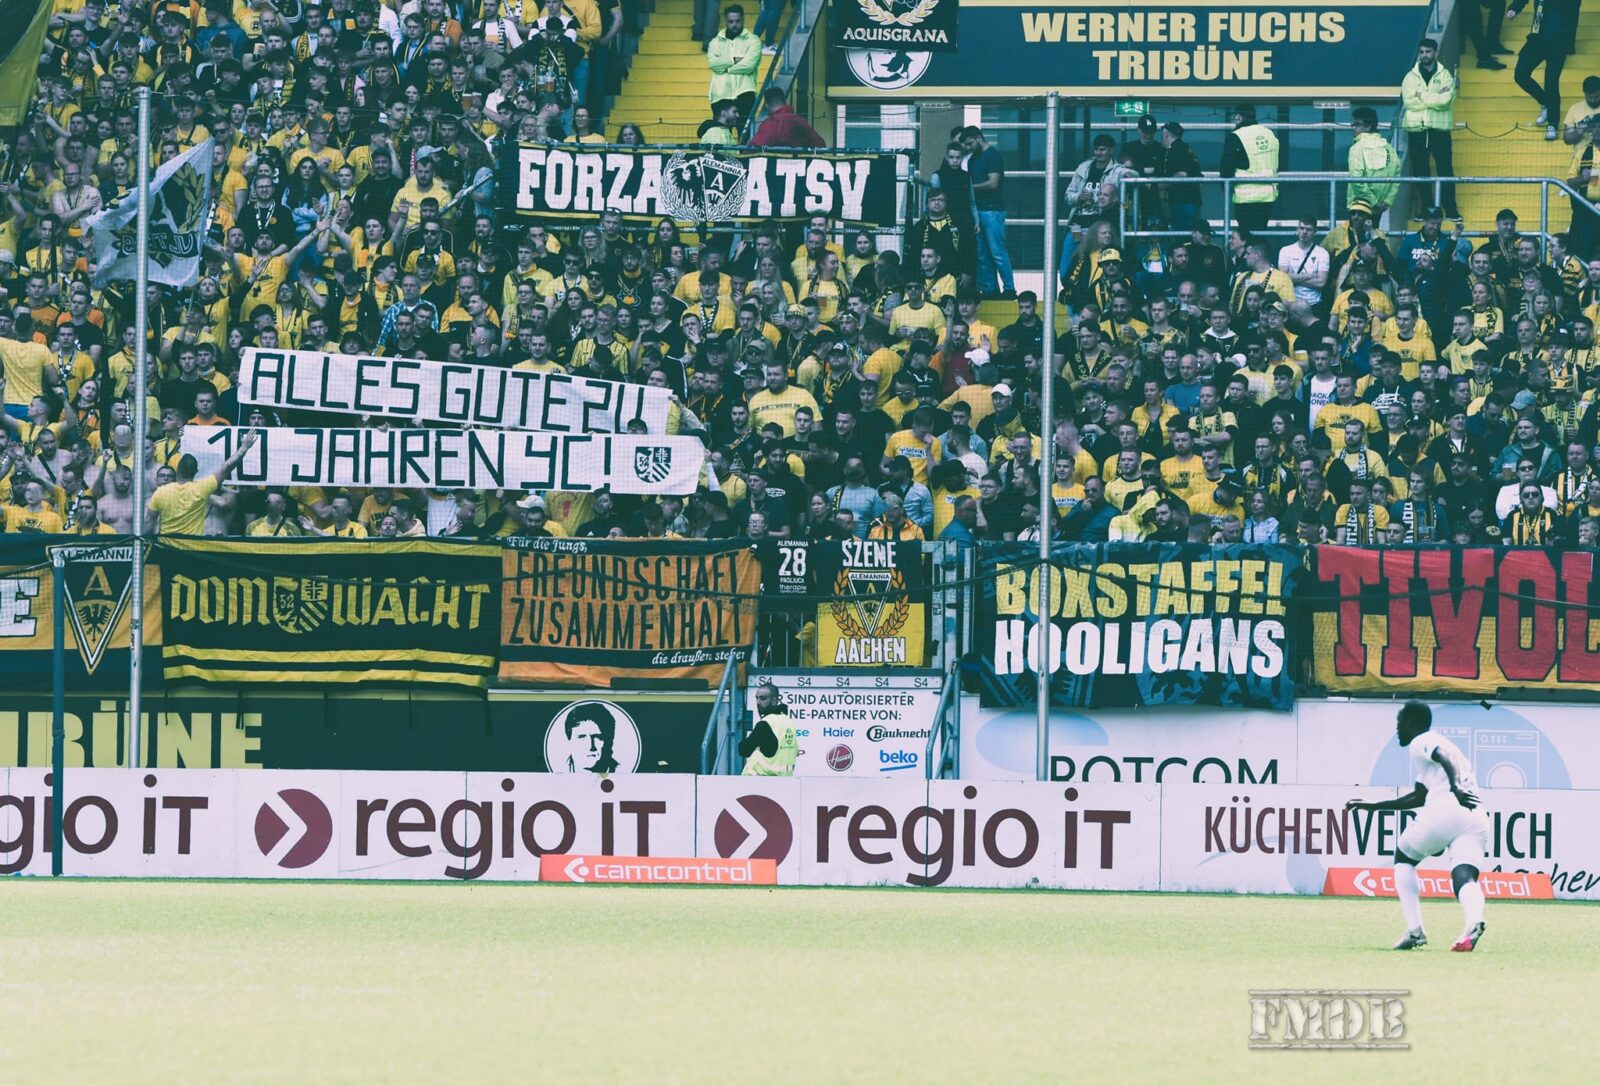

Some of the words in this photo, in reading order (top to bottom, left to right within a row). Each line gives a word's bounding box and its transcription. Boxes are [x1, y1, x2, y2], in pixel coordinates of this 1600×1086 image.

[843, 27, 948, 44] AQUISGRANA
[1022, 12, 1195, 43] WERNER
[1208, 11, 1345, 43] FUCHS
[1093, 45, 1272, 80] TRIBÜNE
[516, 148, 668, 214] FORZA
[738, 157, 871, 220] ATSV
[251, 352, 421, 414] ALLES
[439, 365, 572, 432] GUTE
[207, 428, 268, 482] 10
[291, 428, 505, 488] JAHREN
[520, 435, 612, 492] YC!
[59, 547, 133, 560] ALEMANNI
[507, 536, 531, 548] Für
[533, 536, 550, 550] die
[553, 539, 588, 554] Jungs,
[841, 539, 897, 568] SZENE
[516, 551, 741, 601] FREUNDSCHAFT
[778, 548, 807, 577] 28
[83, 566, 113, 596] A
[996, 559, 1287, 618] BOXSTAFFEL
[508, 598, 742, 650] ZUSAMMENHALT
[1317, 544, 1600, 682] TIVOL
[652, 652, 668, 664] die
[671, 650, 712, 666] draußen
[835, 637, 906, 664] AACHEN
[994, 617, 1286, 678] HOOLIGANS
[797, 677, 812, 687] S4
[836, 677, 850, 687] S4
[875, 677, 889, 687] S4
[914, 677, 928, 687] S4
[787, 694, 816, 704] SIND
[819, 694, 914, 706] AUTORISIERTER
[789, 709, 866, 720] NE-PARTNER
[870, 710, 902, 720] VON:
[823, 727, 854, 737] Haier
[869, 727, 931, 740] Bauknecht
[880, 750, 918, 763] beko
[143, 774, 209, 855] iT
[356, 778, 577, 879] regio
[601, 779, 667, 857] iT
[817, 785, 1039, 887] regio
[1064, 787, 1131, 870] iT
[594, 862, 752, 882] camcontrol
